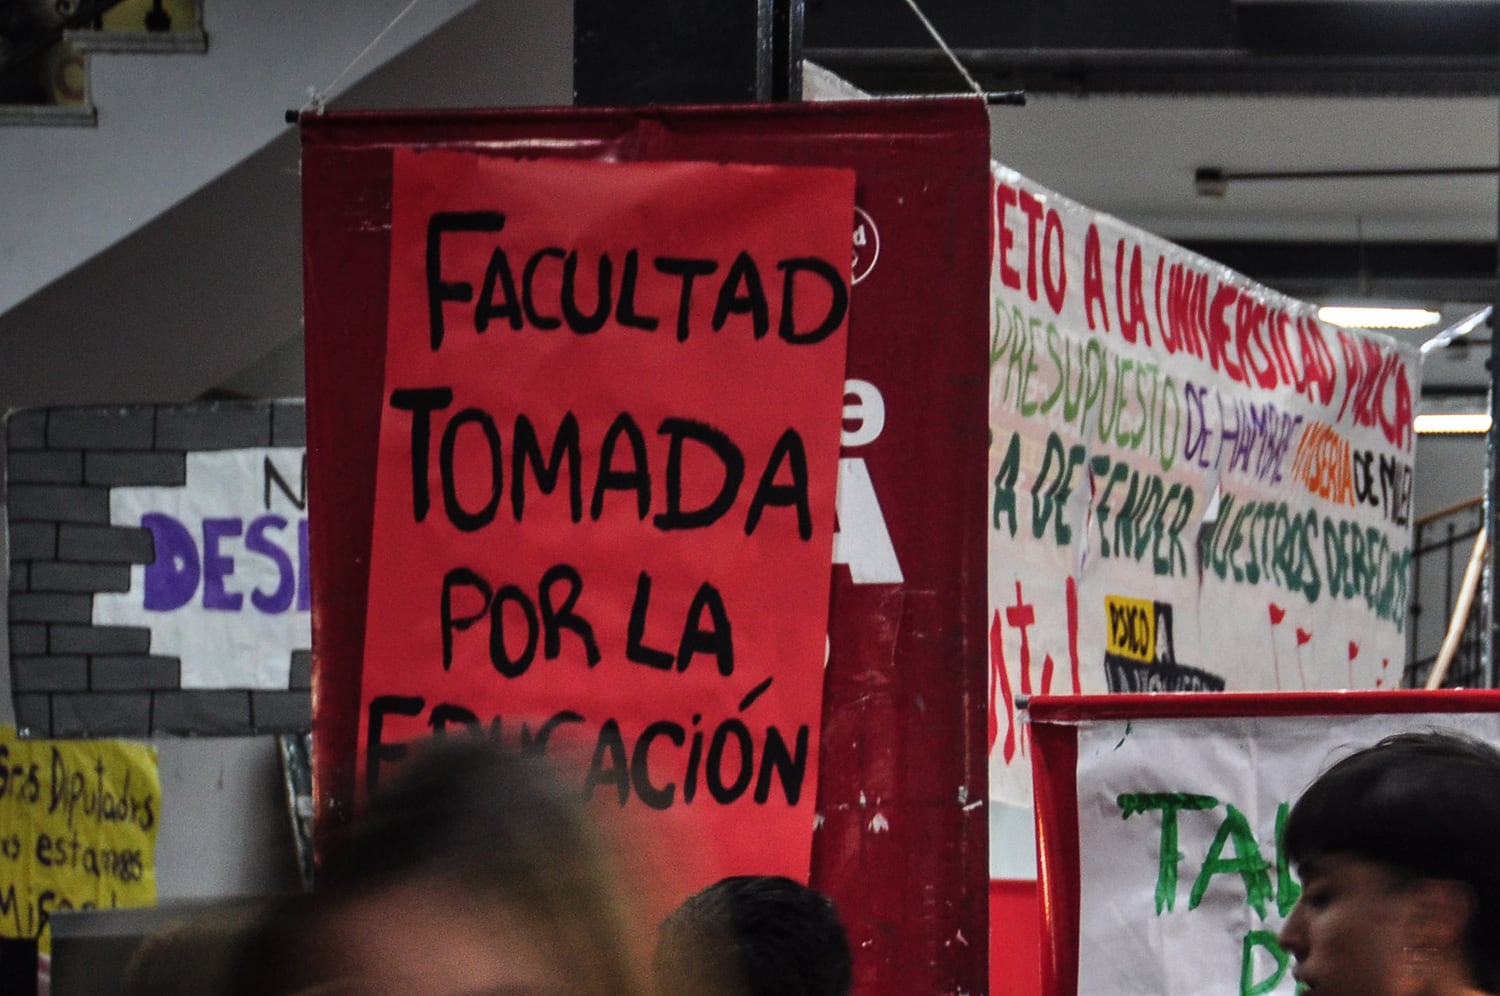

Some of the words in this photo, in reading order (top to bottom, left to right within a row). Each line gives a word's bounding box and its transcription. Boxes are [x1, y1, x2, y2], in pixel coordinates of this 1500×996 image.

[427, 211, 850, 351] FACULTAD
[990, 175, 1067, 315] ETO
[1084, 222, 1110, 331] A
[1115, 239, 1152, 347] LA
[390, 386, 812, 541] TOMADA
[990, 300, 1180, 470] PRESUPUESTO
[1184, 381, 1213, 468] DE
[1352, 450, 1379, 507] DE
[442, 563, 600, 678] POR
[626, 572, 734, 676] LA
